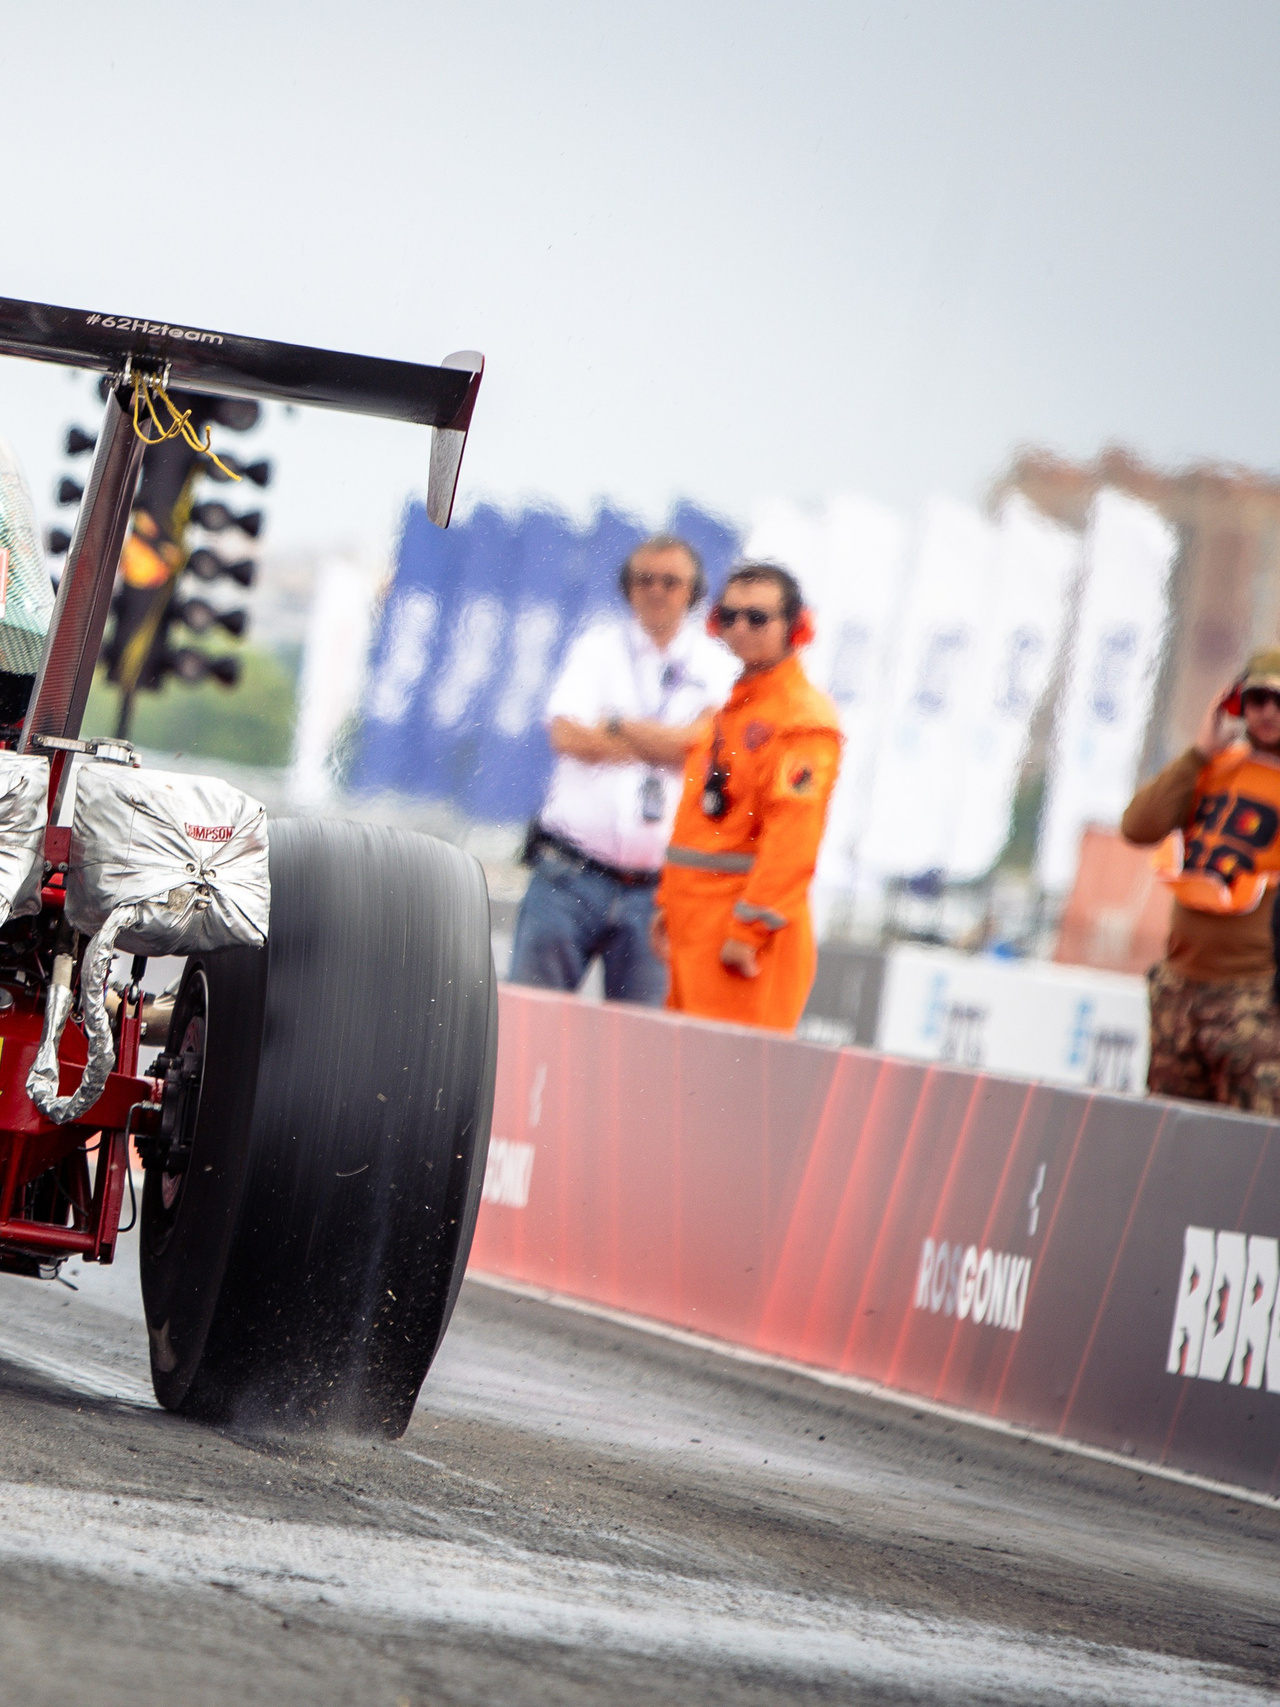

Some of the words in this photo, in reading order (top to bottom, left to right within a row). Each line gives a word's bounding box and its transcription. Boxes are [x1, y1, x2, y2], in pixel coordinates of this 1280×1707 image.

[86, 313, 224, 345] #62Hzteam
[188, 824, 233, 841] SIMPSON
[915, 1239, 1032, 1332] ROSGONKI
